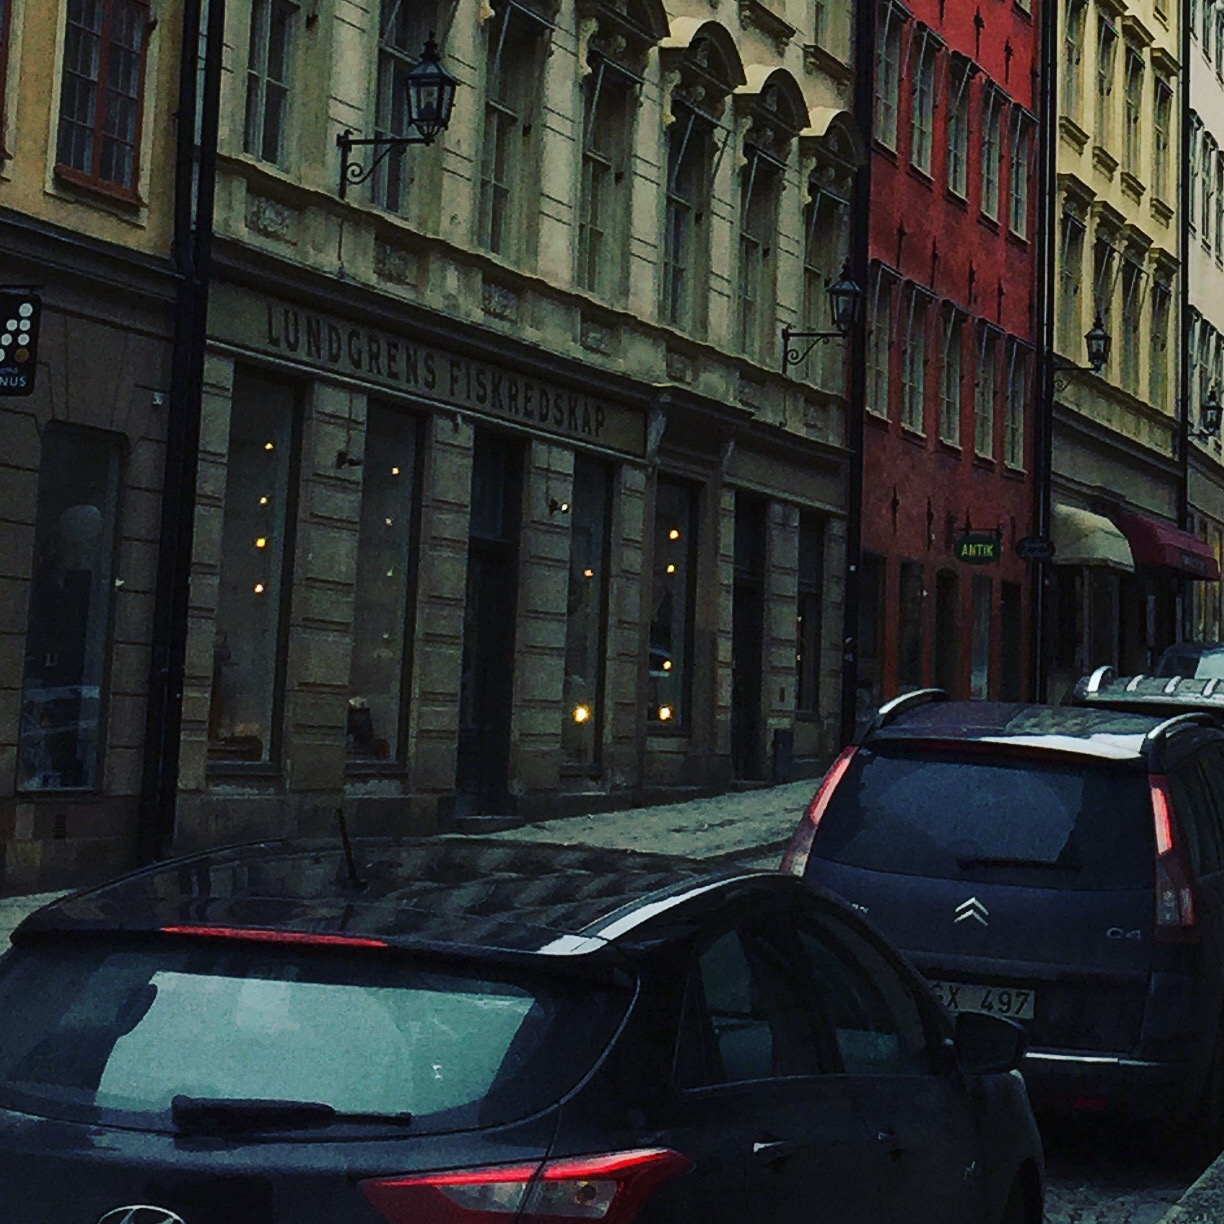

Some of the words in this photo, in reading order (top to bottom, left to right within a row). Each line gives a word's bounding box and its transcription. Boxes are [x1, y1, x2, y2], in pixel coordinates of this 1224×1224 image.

[267, 305, 436, 391] LUNDGRENS
[450, 358, 605, 438] FISKREDSKAP
[961, 543, 994, 557] ANTIK
[981, 989, 1029, 1014] 497
